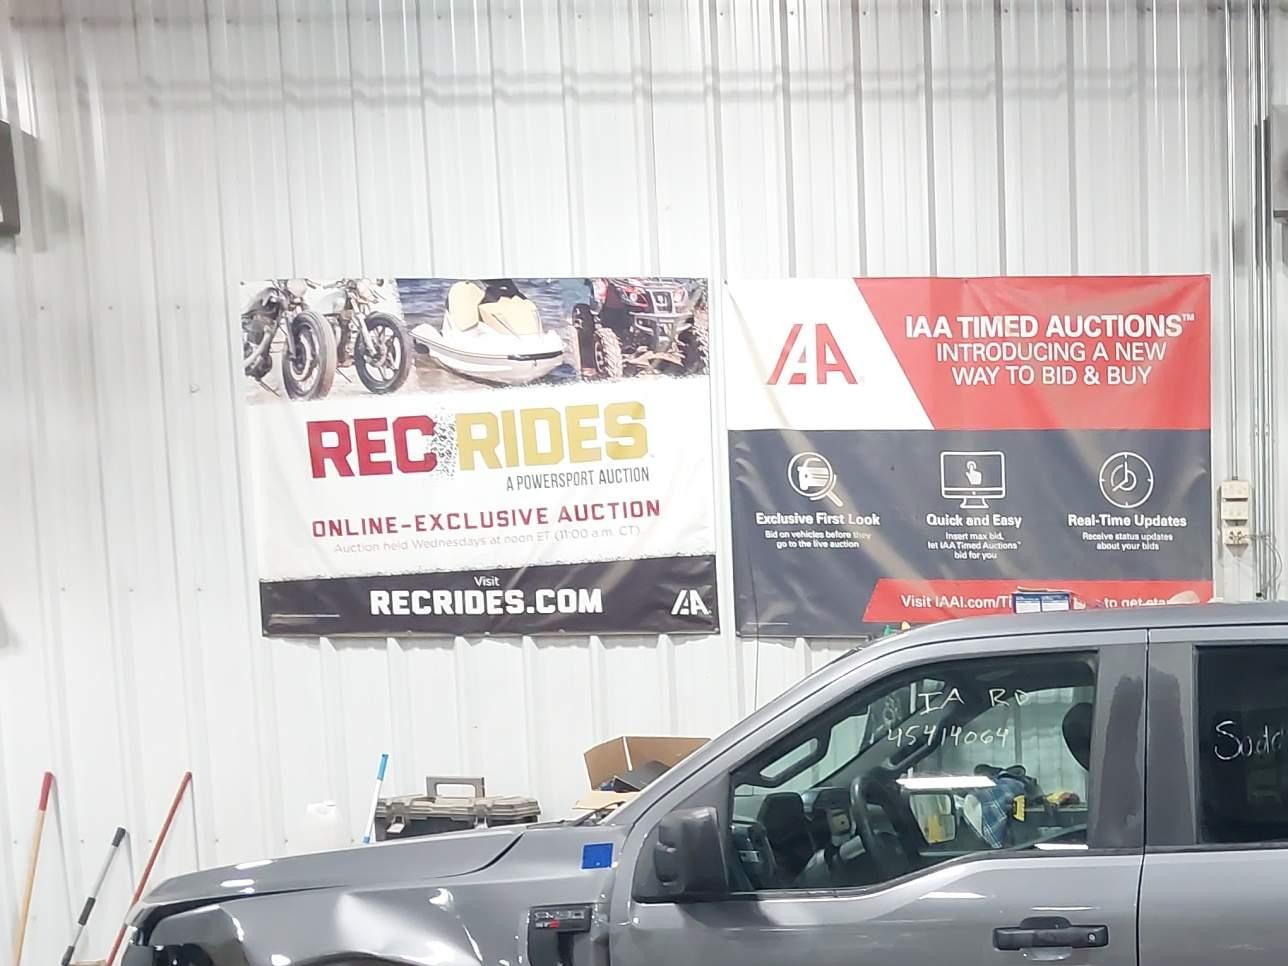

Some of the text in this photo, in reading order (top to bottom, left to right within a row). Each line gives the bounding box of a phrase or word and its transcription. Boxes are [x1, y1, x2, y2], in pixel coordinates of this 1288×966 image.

[905, 315, 953, 339] IAA
[956, 315, 1039, 339] TIMED
[936, 341, 1167, 363] INTRODUCING A NEW
[951, 365, 1152, 386] WAY TO BID & BUY
[306, 401, 649, 479] REC RIDES
[506, 466, 650, 491] A POWERSPORT AUCTION
[312, 499, 660, 538] ONLINE-EXCLUSIVE AUCTION
[755, 512, 880, 526] Exclusive First Look
[926, 513, 1022, 529] Quick and Easy
[1067, 513, 1187, 528] Real-Time Updates
[334, 542, 379, 553] Auction
[412, 535, 486, 550] Wednesdays
[489, 534, 501, 545] at
[504, 533, 534, 544] noon
[537, 531, 550, 543] ET
[764, 530, 778, 539] Bid
[779, 531, 790, 539] on
[791, 530, 825, 539] vehicles
[825, 530, 852, 539] before
[945, 532, 969, 540] Insert
[969, 533, 988, 541] max
[1082, 532, 1174, 542] Receive status updates
[776, 540, 860, 550] go to the live auction
[927, 541, 939, 549] let
[956, 541, 982, 549] Timed
[1096, 541, 1160, 552] about your bids
[954, 550, 997, 561] bid for you
[473, 576, 501, 587] Visit
[369, 588, 604, 616] RECRIDES.COM
[901, 595, 932, 608] Visit
[935, 594, 1013, 609] IAAI.com/Ti
[1104, 598, 1117, 608] to
[887, 722, 1010, 748] 45414064
